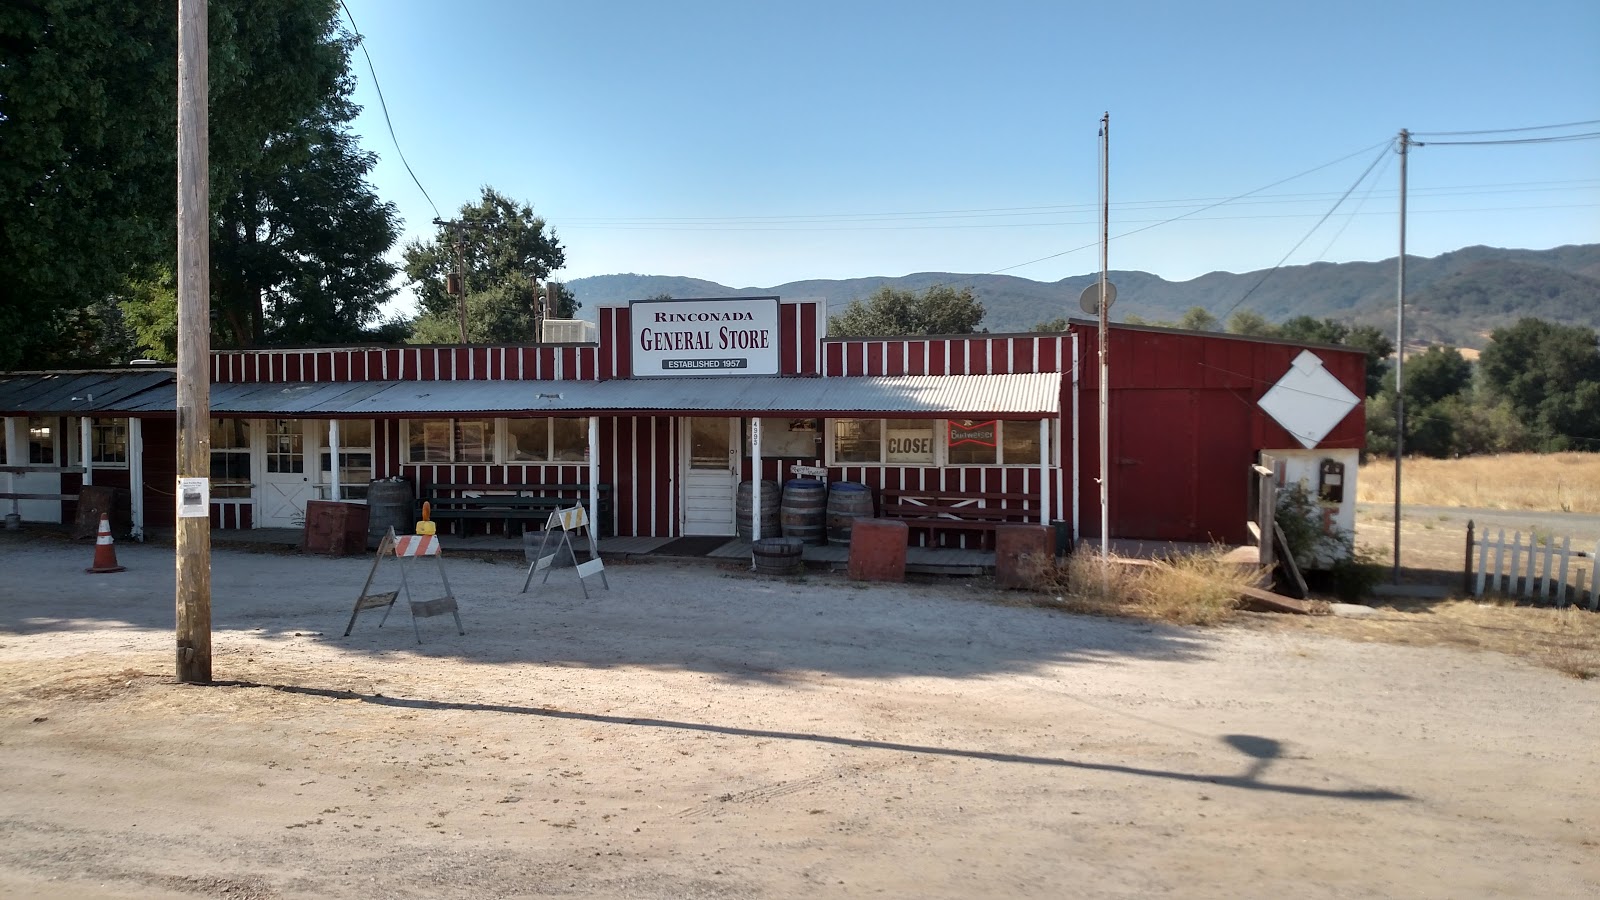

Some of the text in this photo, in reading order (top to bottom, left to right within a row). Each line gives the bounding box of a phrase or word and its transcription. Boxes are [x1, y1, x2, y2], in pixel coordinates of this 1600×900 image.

[654, 312, 754, 322] RINCONADA
[640, 326, 769, 351] GENERAL STORE
[668, 359, 741, 368] ESTABLISHED 1957
[951, 429, 993, 440] Budweiser
